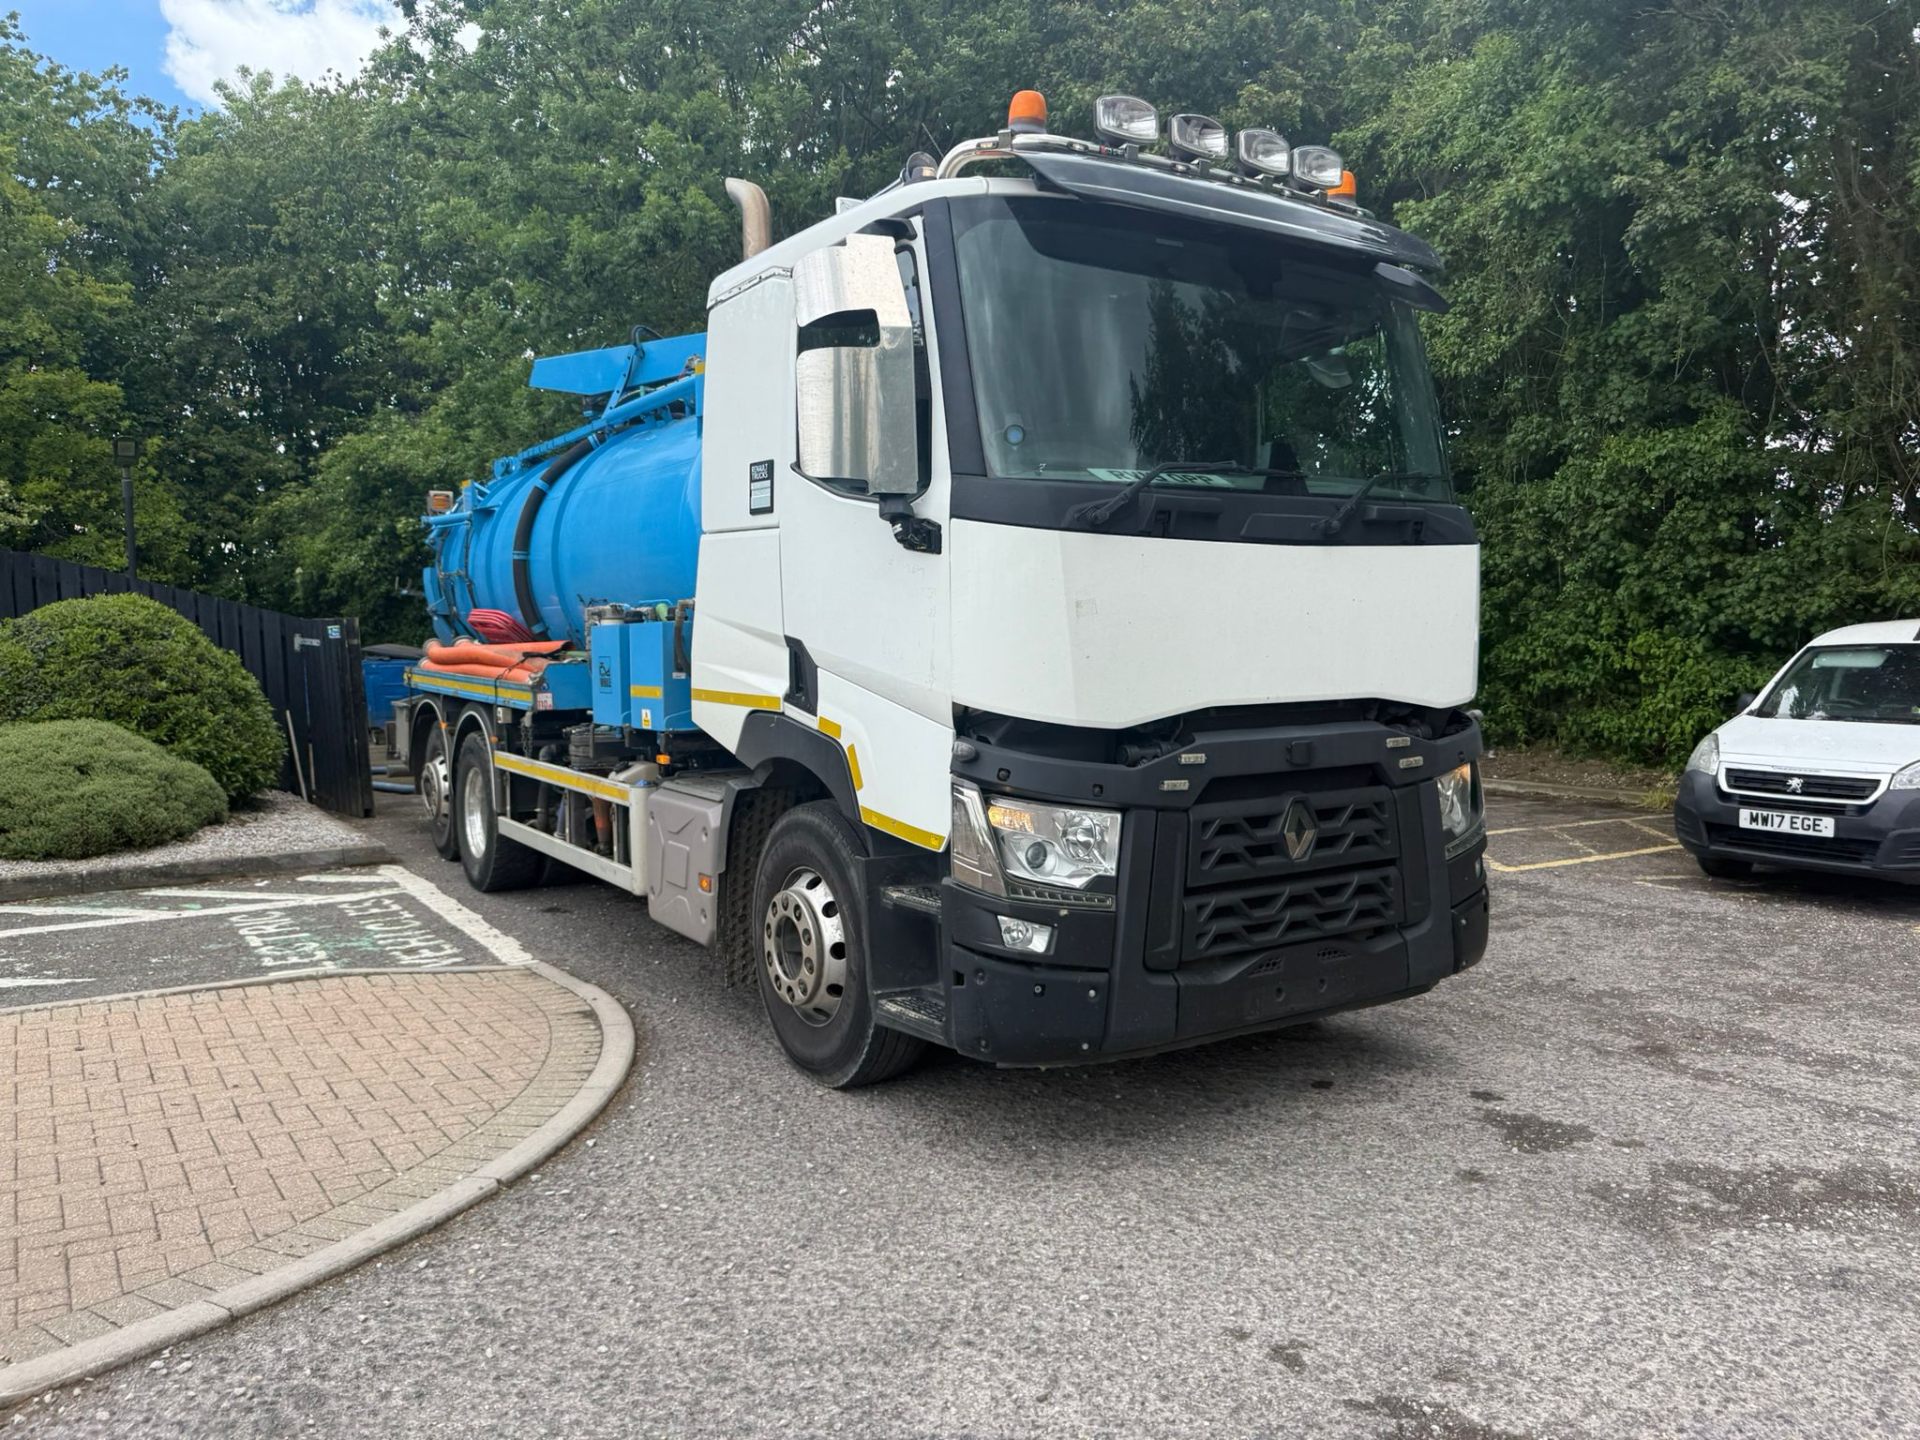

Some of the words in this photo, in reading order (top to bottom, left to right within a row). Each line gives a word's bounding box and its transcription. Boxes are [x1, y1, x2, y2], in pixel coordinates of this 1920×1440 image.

[752, 471, 768, 481] TRUCKS
[1749, 811, 1785, 828] MW17
[1789, 816, 1823, 832] EGE
[229, 911, 338, 976] LECTRIC
[338, 899, 467, 968] VEHICLES
